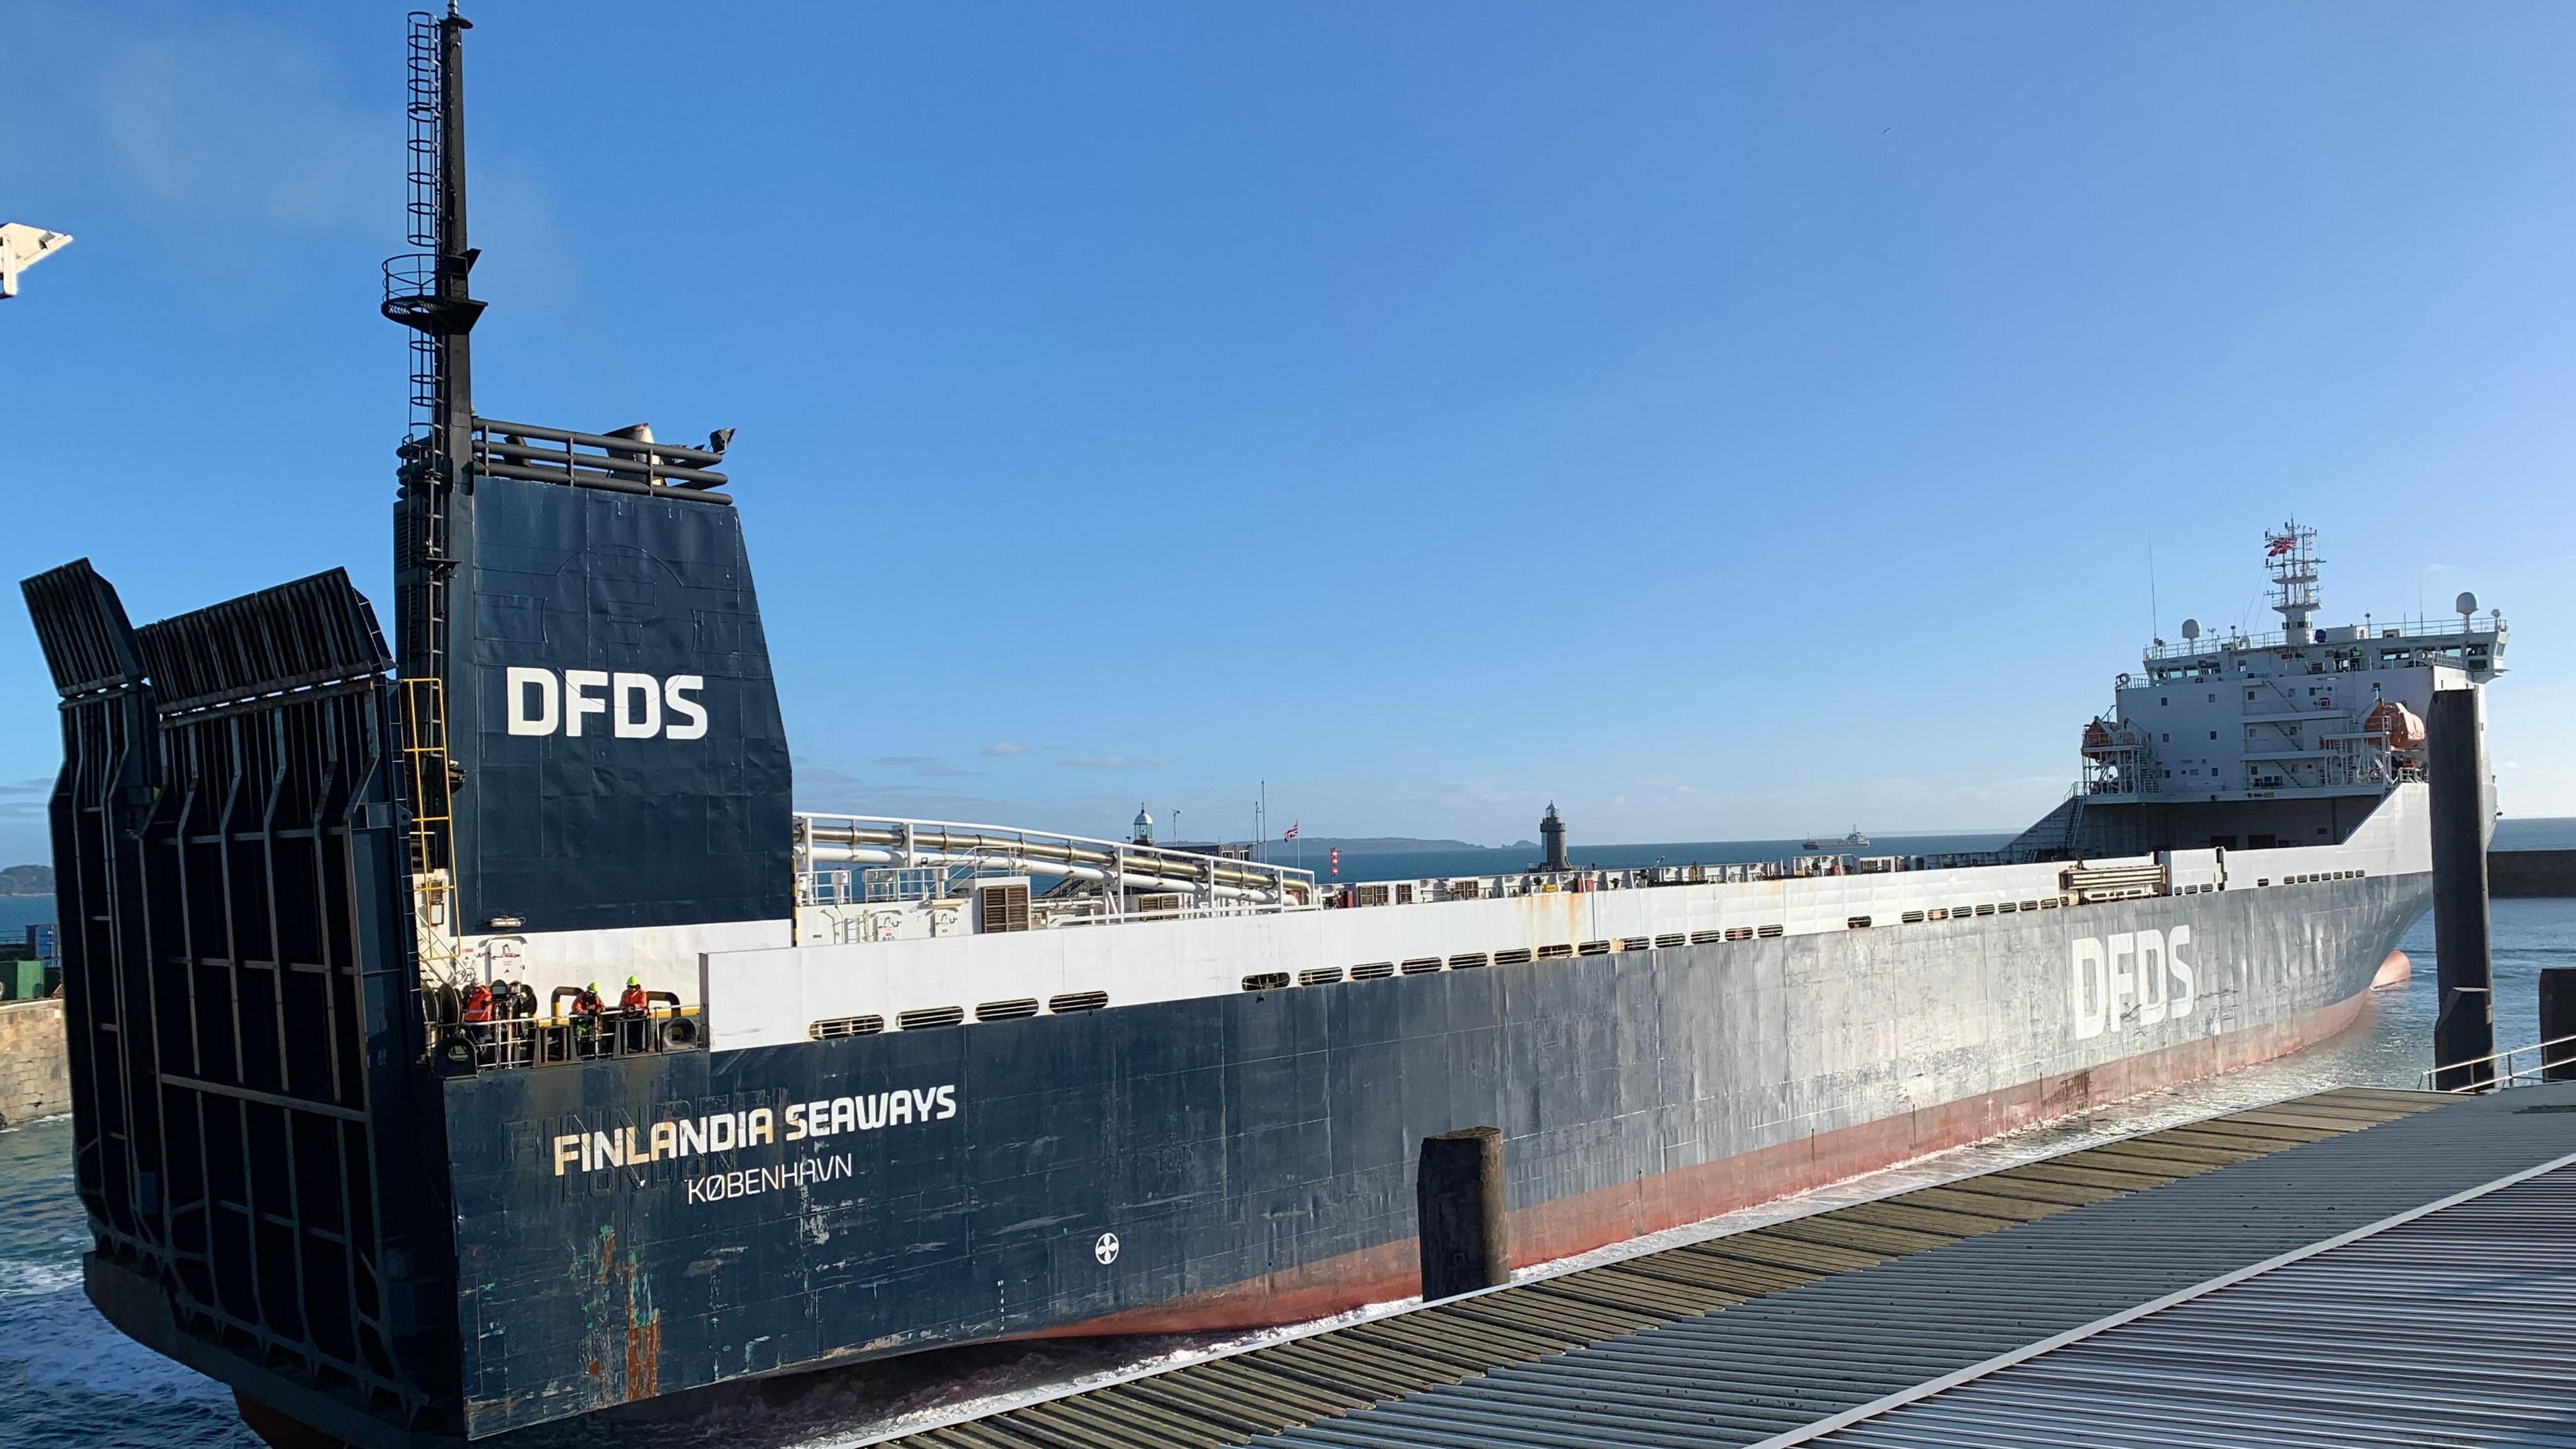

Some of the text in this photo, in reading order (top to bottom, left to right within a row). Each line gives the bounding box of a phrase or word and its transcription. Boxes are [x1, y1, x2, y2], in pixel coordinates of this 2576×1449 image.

[506, 666, 708, 740] DFDS
[2072, 924, 2195, 1040] DFDS
[553, 1084, 957, 1176] FINLANDIA SEAWAYS
[687, 1152, 853, 1205] KØBENHAVN
